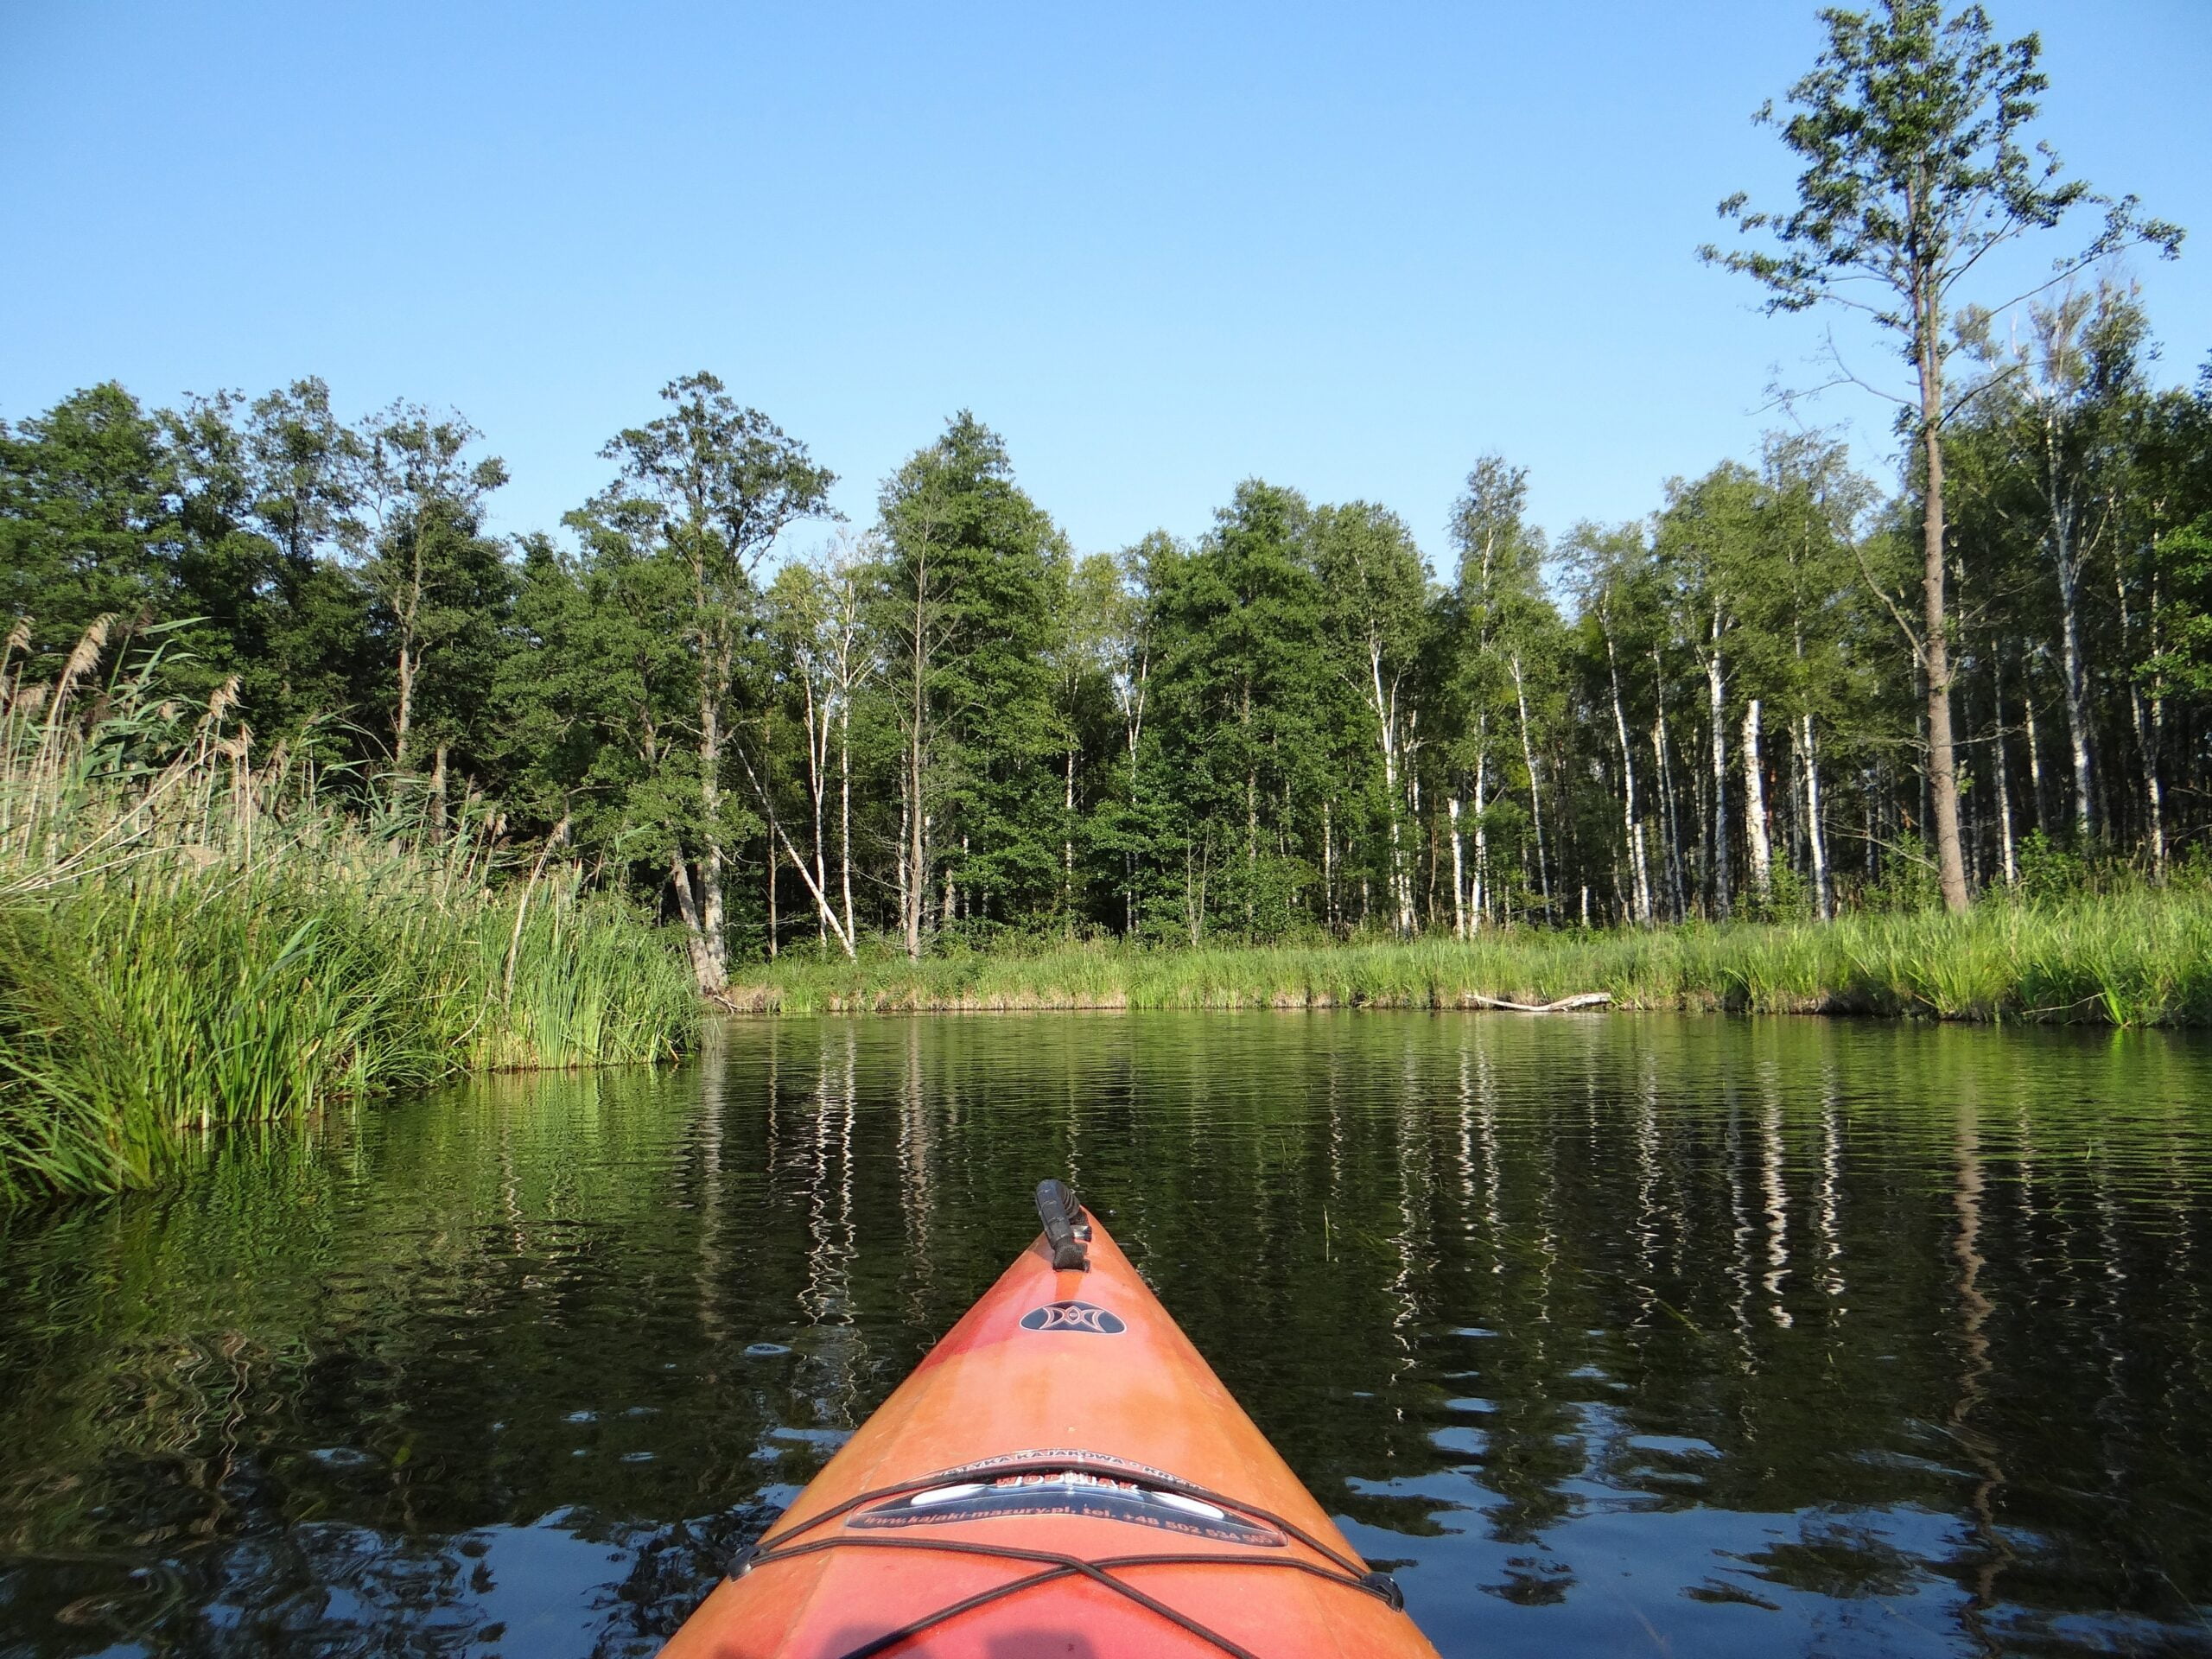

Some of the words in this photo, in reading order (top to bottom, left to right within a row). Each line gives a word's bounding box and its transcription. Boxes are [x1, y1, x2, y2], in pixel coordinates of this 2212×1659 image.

[1016, 1449, 1126, 1465] KAJAKOWA
[1083, 1507, 1116, 1518] tel.
[1123, 1513, 1160, 1526] +48
[1164, 1520, 1201, 1533] 502
